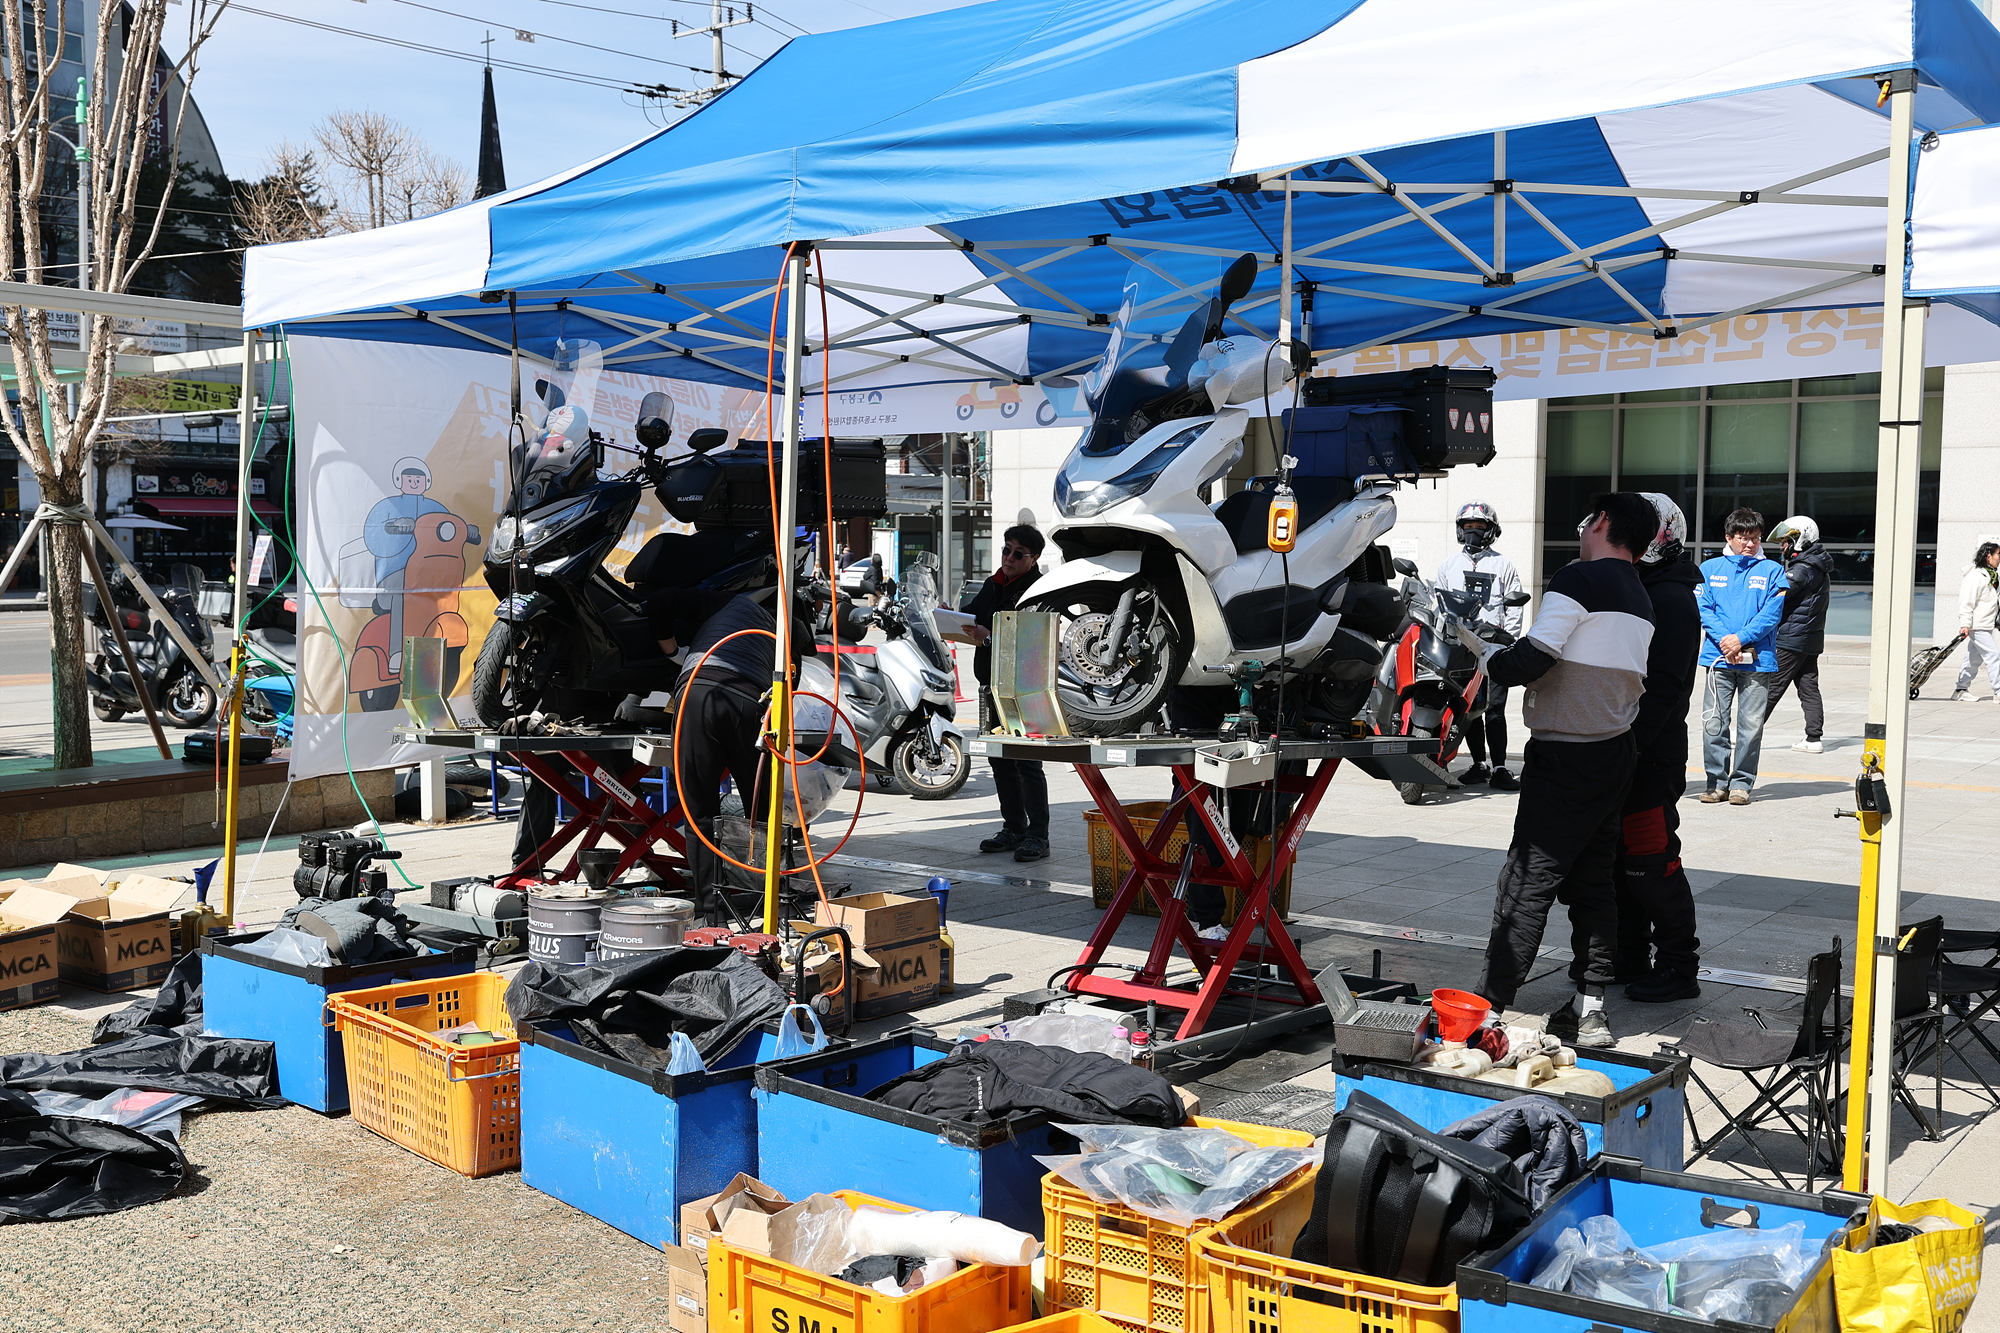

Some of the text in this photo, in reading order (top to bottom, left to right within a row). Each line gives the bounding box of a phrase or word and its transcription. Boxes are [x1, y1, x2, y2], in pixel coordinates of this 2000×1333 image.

[605, 778, 632, 801] BRIGHT
[117, 936, 166, 963] MCA
[603, 932, 644, 944] KRMOTORS
[0, 953, 52, 980] MCA
[879, 954, 928, 989] MCA
[913, 982, 933, 993] 10W-40
